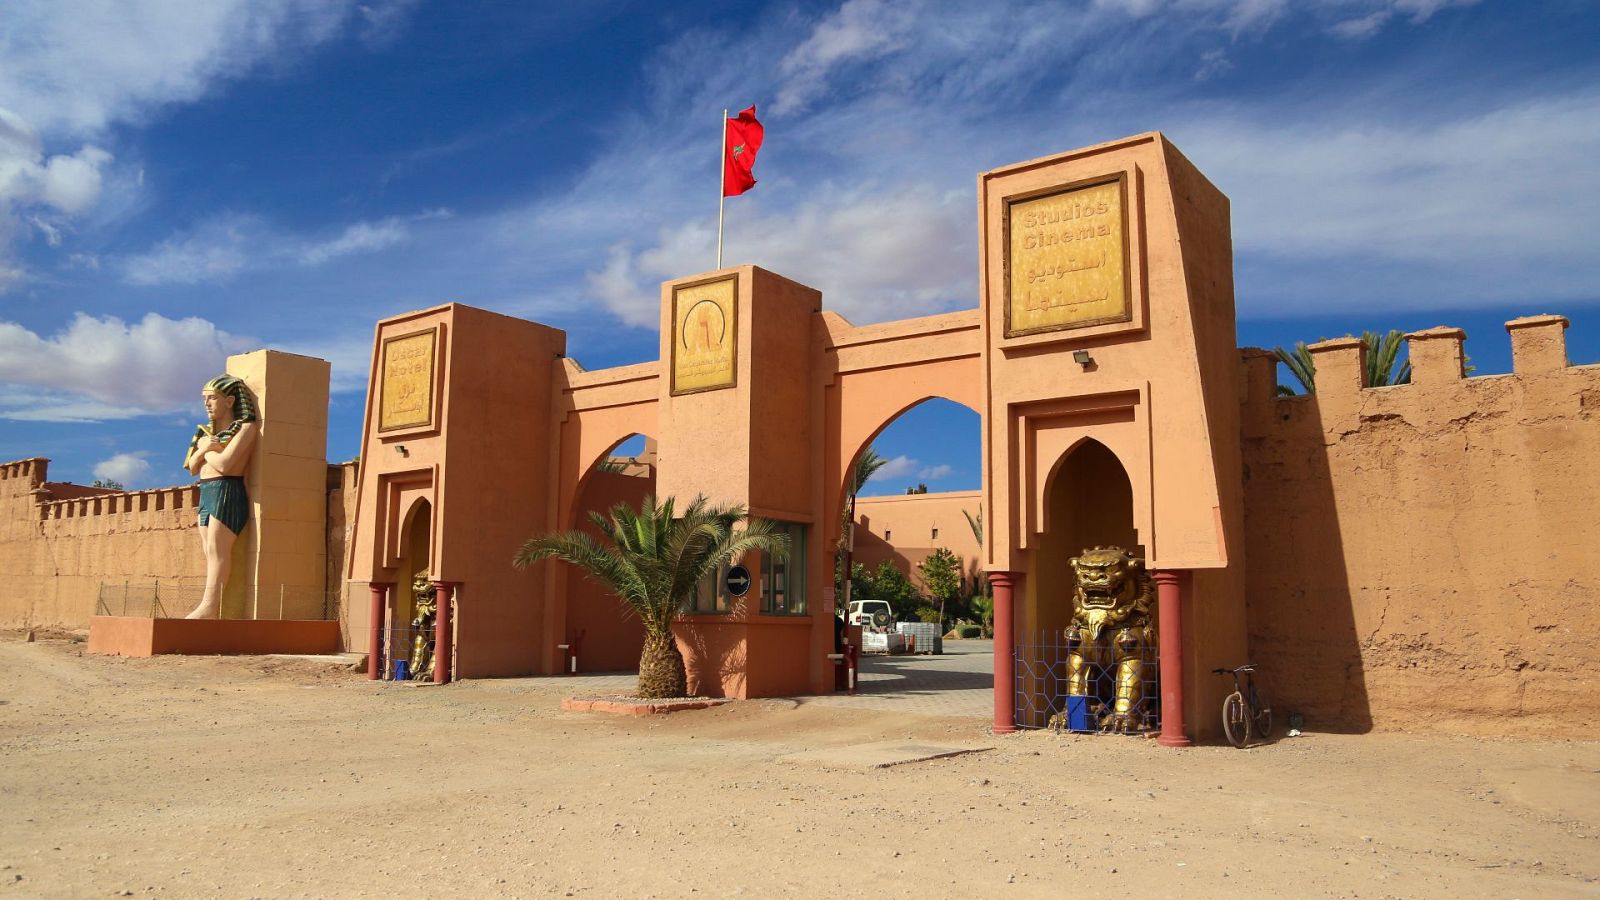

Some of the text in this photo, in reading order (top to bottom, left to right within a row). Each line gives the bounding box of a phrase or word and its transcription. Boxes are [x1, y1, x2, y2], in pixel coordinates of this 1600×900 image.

[1024, 202, 1109, 228] Studios
[1024, 224, 1111, 250] Cinema
[1026, 289, 1109, 313] سينما
